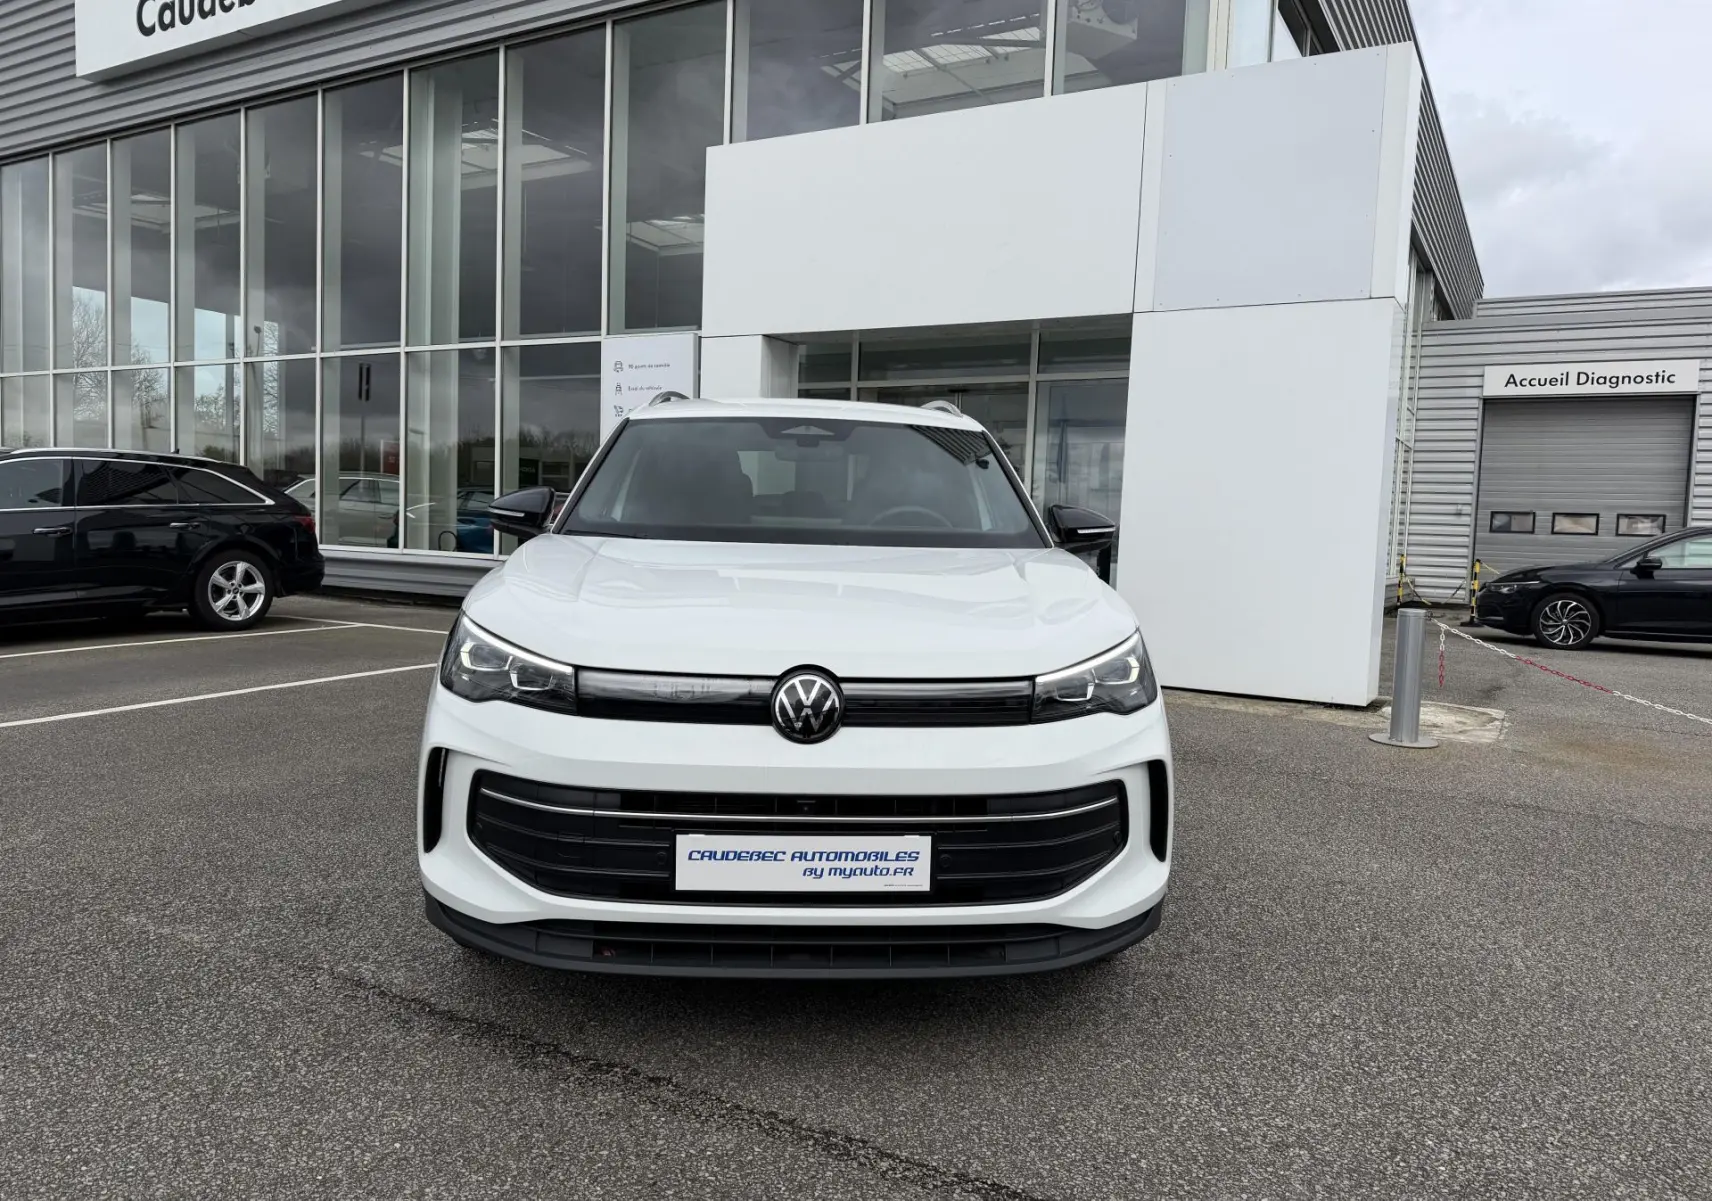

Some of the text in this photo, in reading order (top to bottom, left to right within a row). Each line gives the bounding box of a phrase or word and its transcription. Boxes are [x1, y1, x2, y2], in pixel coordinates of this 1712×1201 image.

[1504, 370, 1676, 389] Accueil Diagnostic
[778, 677, 837, 733] VW
[687, 850, 921, 862] CAUDEBEC AUTOMOBILES
